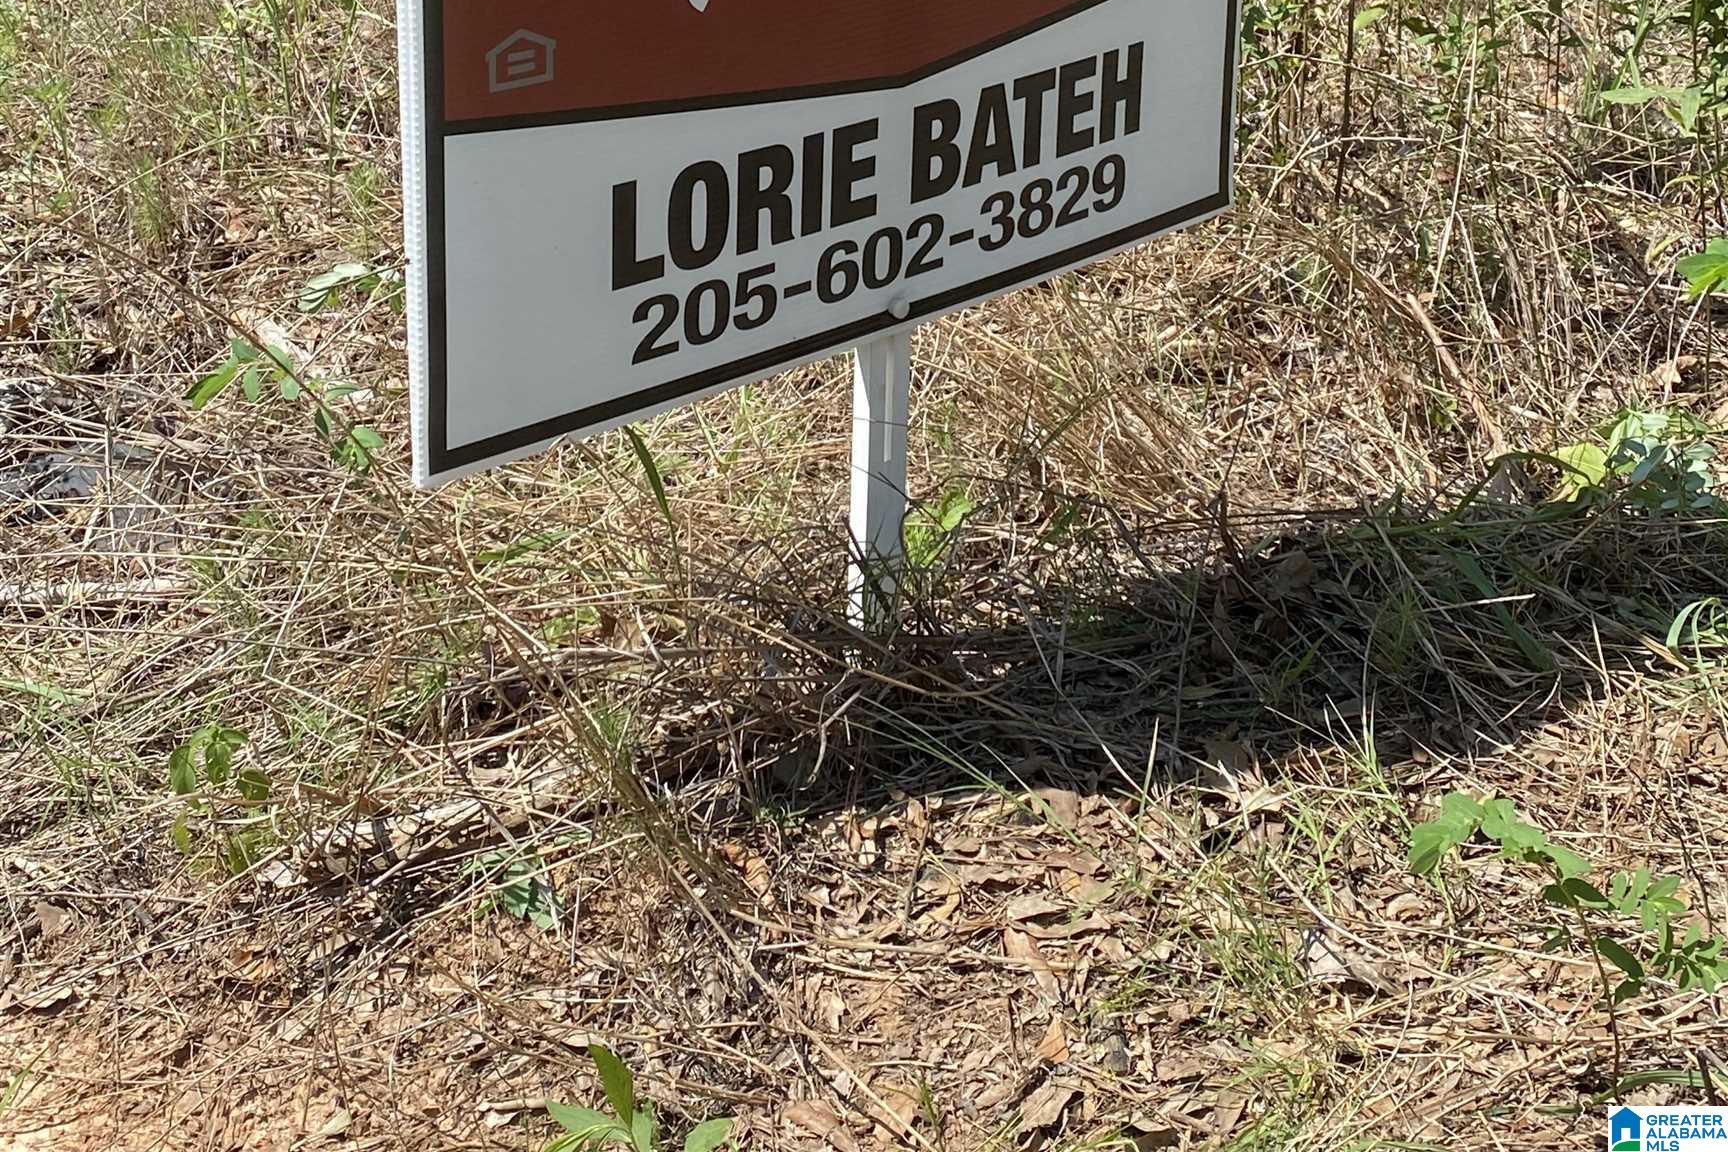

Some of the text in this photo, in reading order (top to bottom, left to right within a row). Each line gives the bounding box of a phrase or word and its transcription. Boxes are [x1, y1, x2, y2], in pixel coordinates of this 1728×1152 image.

[612, 41, 1144, 291] LORIE BATEH
[632, 154, 1126, 365] 205-602-3829
